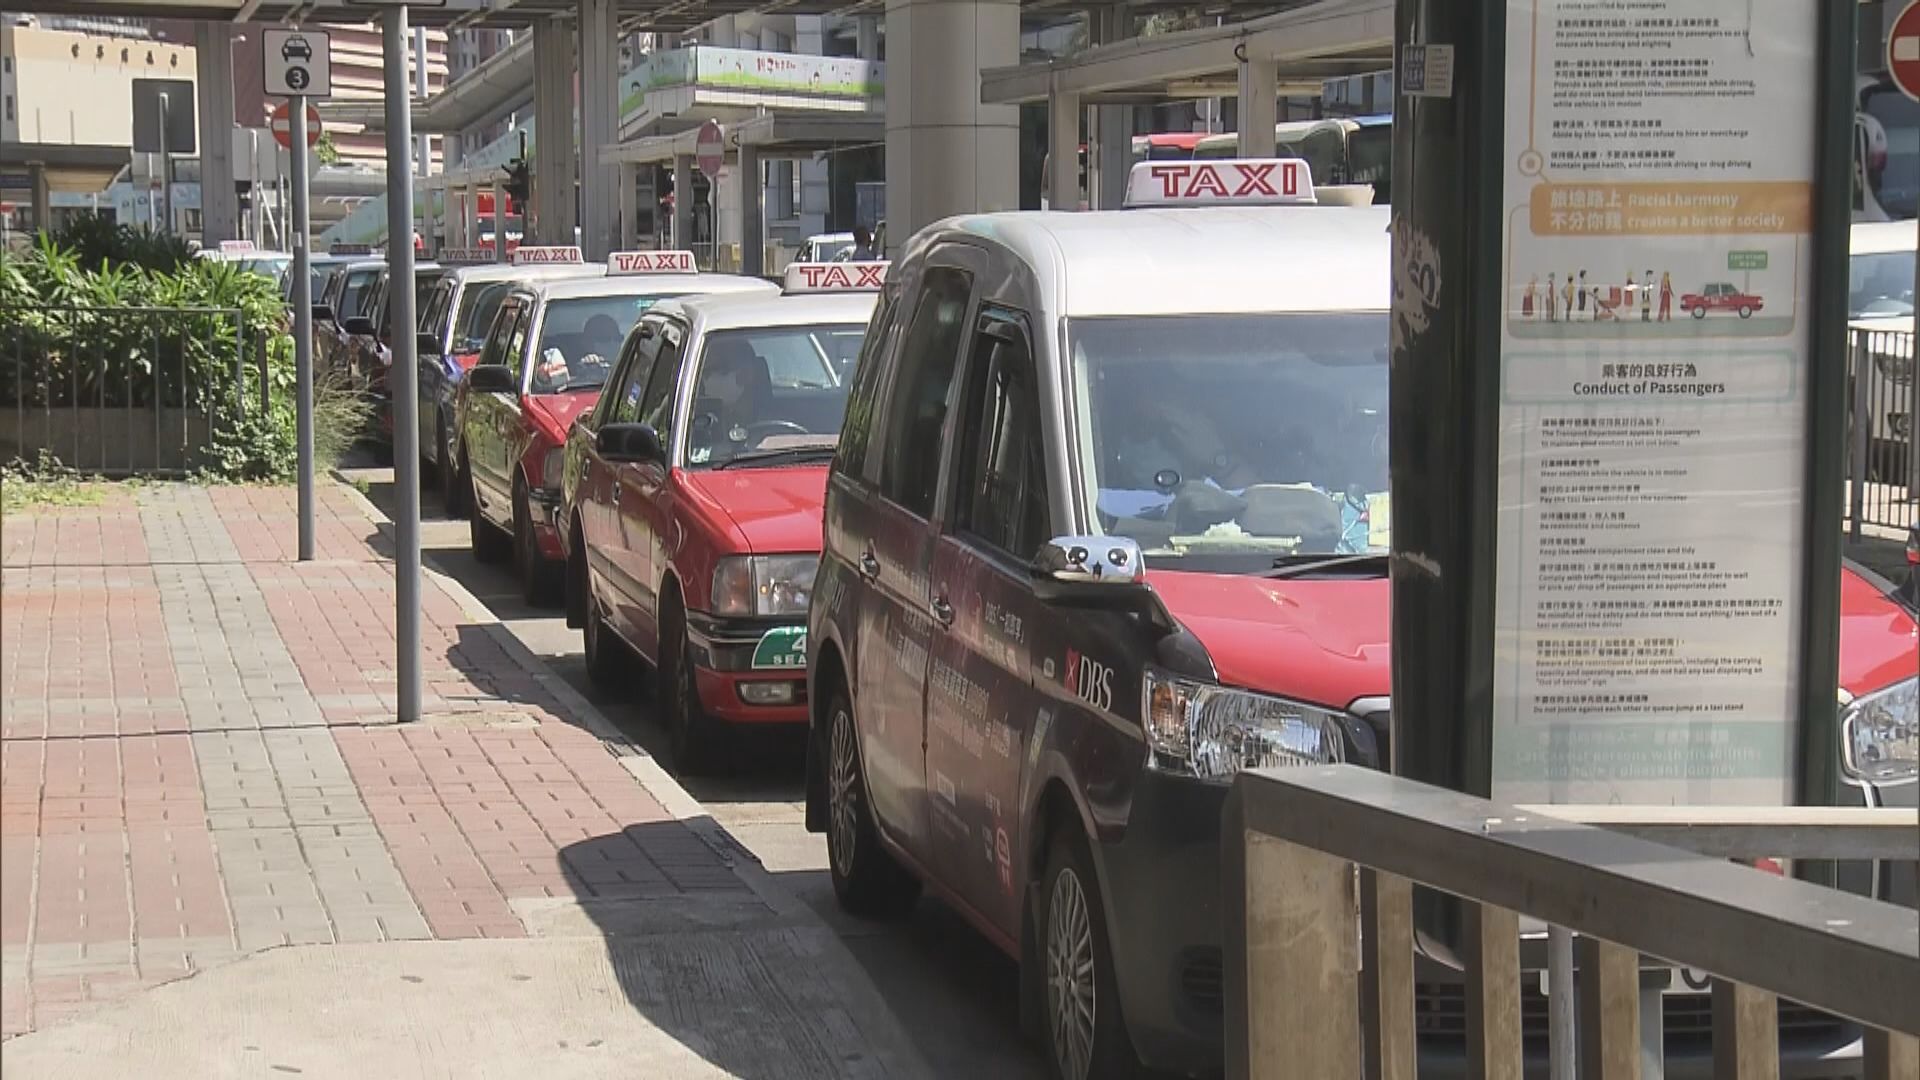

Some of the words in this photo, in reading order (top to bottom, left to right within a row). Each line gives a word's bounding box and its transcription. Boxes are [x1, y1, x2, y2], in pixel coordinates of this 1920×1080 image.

[292, 70, 303, 87] 3
[1152, 163, 1297, 197] TAXI
[1736, 212, 1784, 232] society
[443, 250, 492, 261] TAXI
[520, 248, 577, 261] TAXI
[615, 253, 689, 271] TAXI
[799, 265, 882, 287] TAX
[1573, 381, 1631, 394] Conduct
[1633, 381, 1648, 394] of
[1650, 380, 1725, 397] Passengers
[791, 633, 807, 653] 4
[773, 654, 807, 665] SEA
[1078, 655, 1114, 713] DBS
